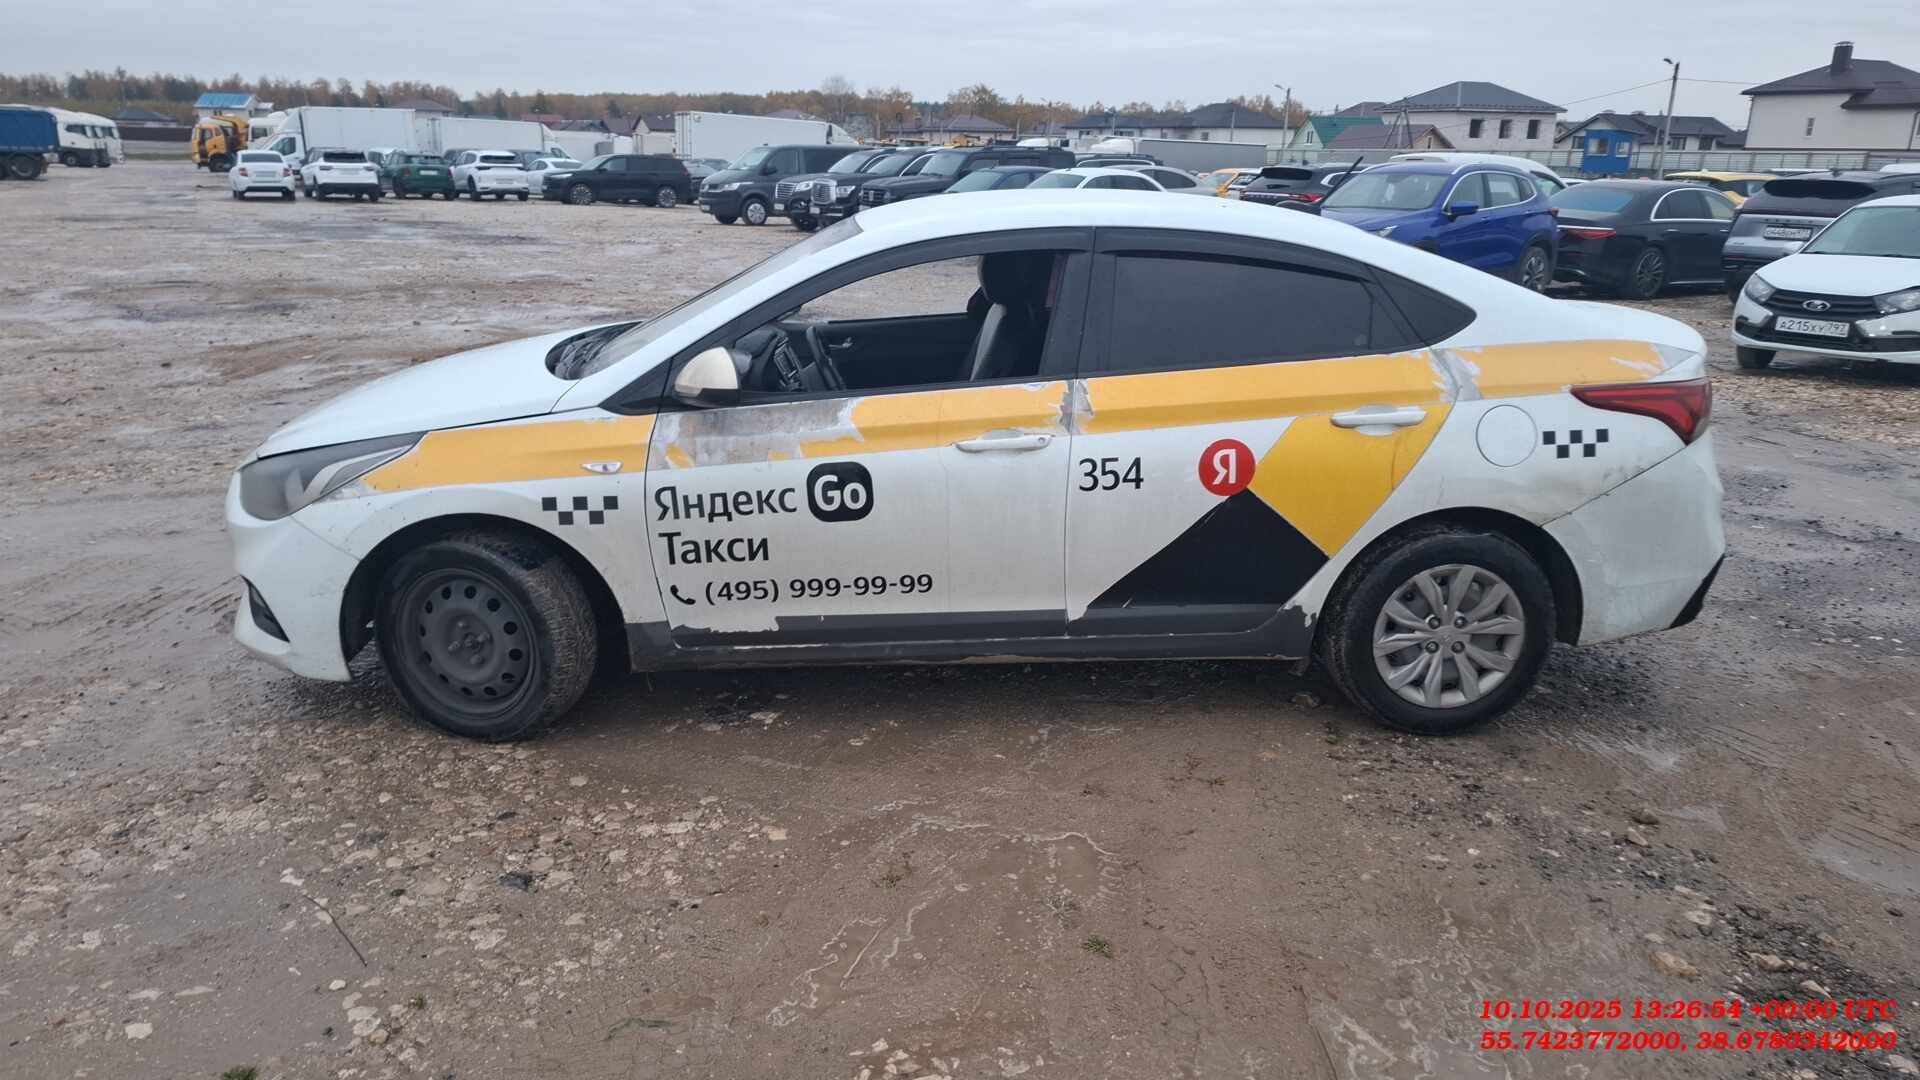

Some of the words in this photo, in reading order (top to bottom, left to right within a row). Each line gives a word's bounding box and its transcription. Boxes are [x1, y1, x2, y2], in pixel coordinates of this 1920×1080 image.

[1078, 456, 1144, 492] 354
[1212, 448, 1237, 485] Я
[654, 486, 798, 523] Яндекс
[813, 474, 867, 512] Go
[658, 531, 770, 565] Такси
[704, 579, 780, 606] (495)
[789, 573, 933, 599] 999-99-99
